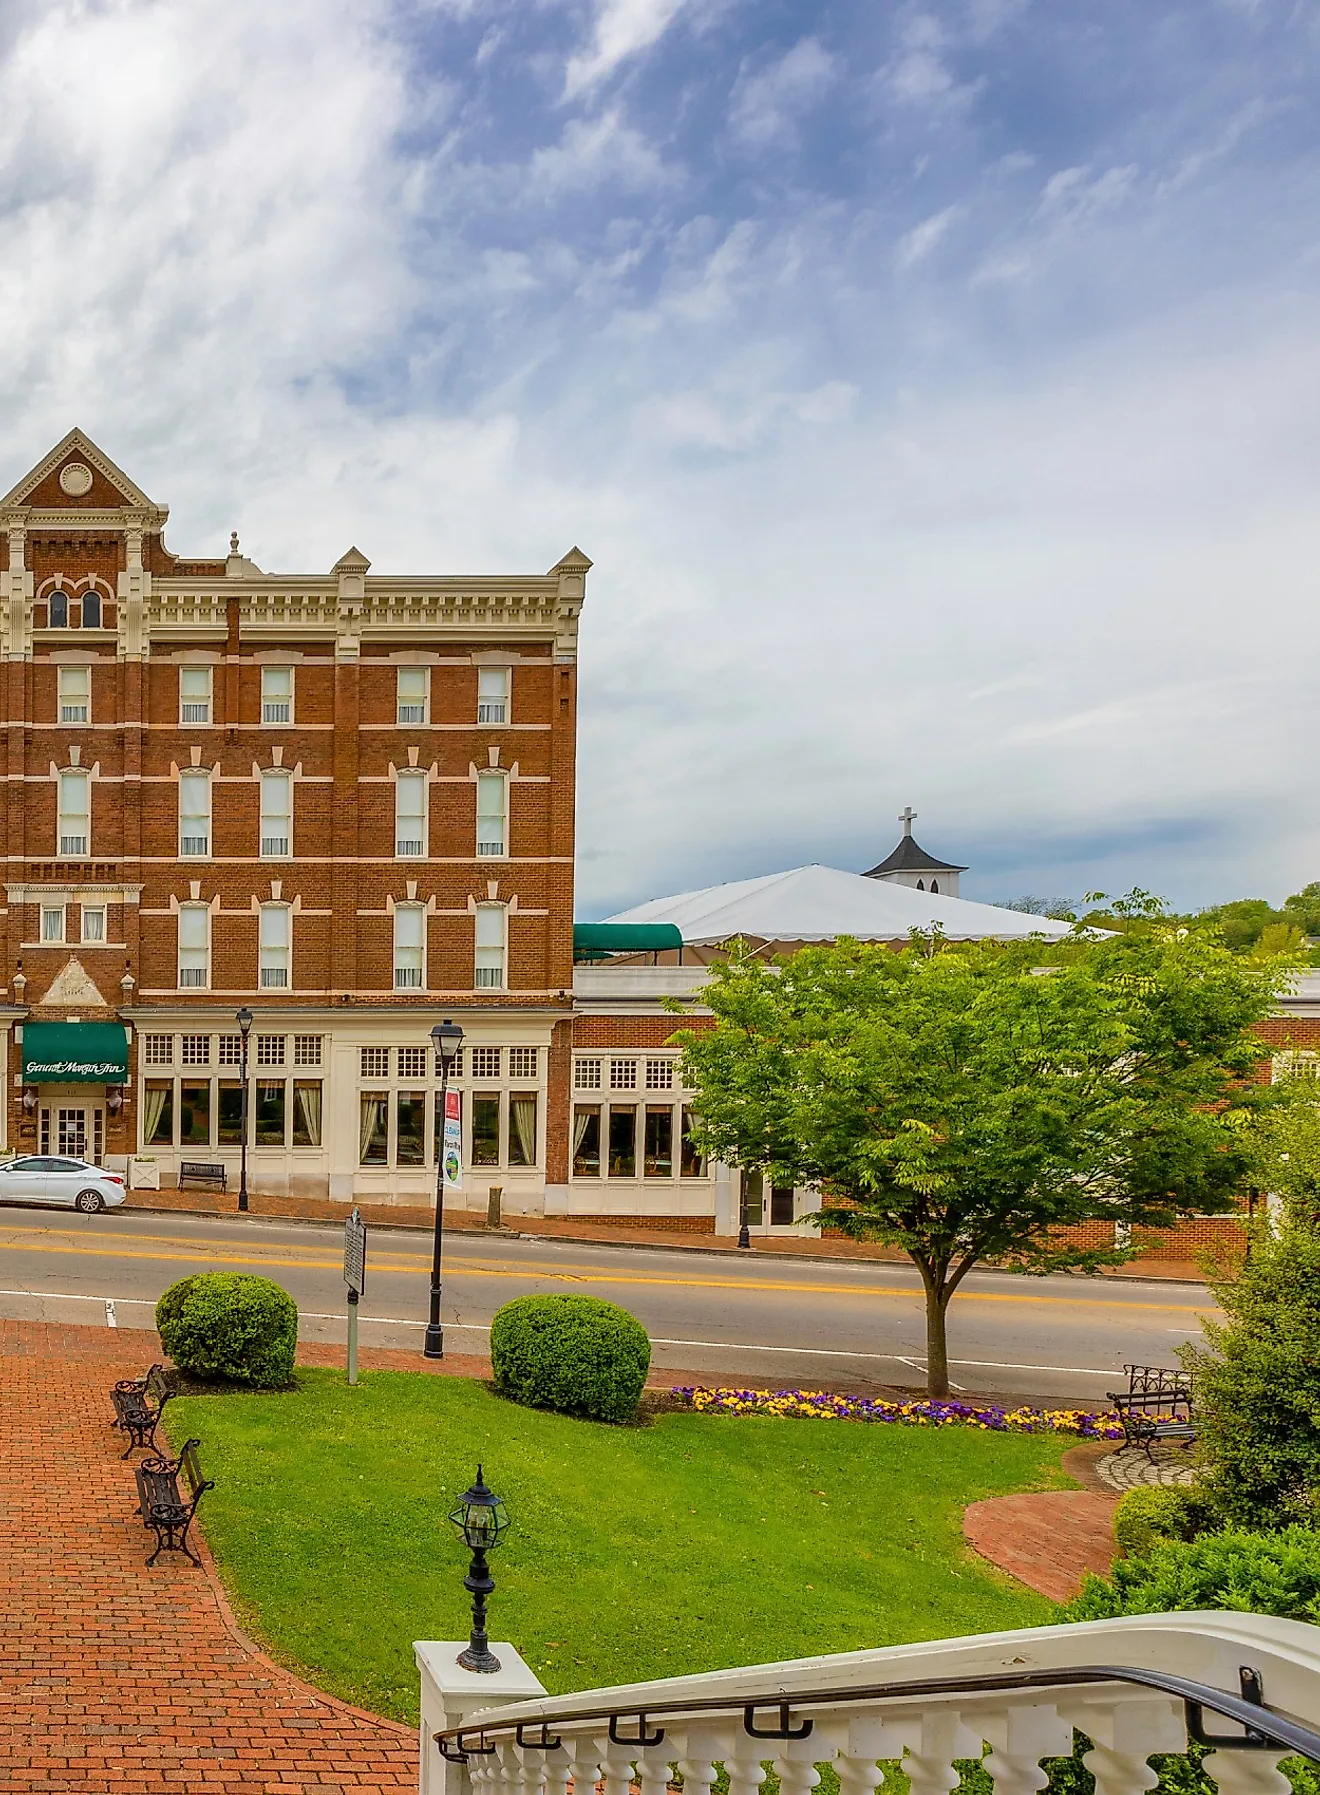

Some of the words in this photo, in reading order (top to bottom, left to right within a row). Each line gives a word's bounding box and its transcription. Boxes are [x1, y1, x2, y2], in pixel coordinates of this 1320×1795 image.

[25, 1062, 65, 1074] General
[62, 1061, 98, 1075] Morgan
[95, 1063, 125, 1075] Inn
